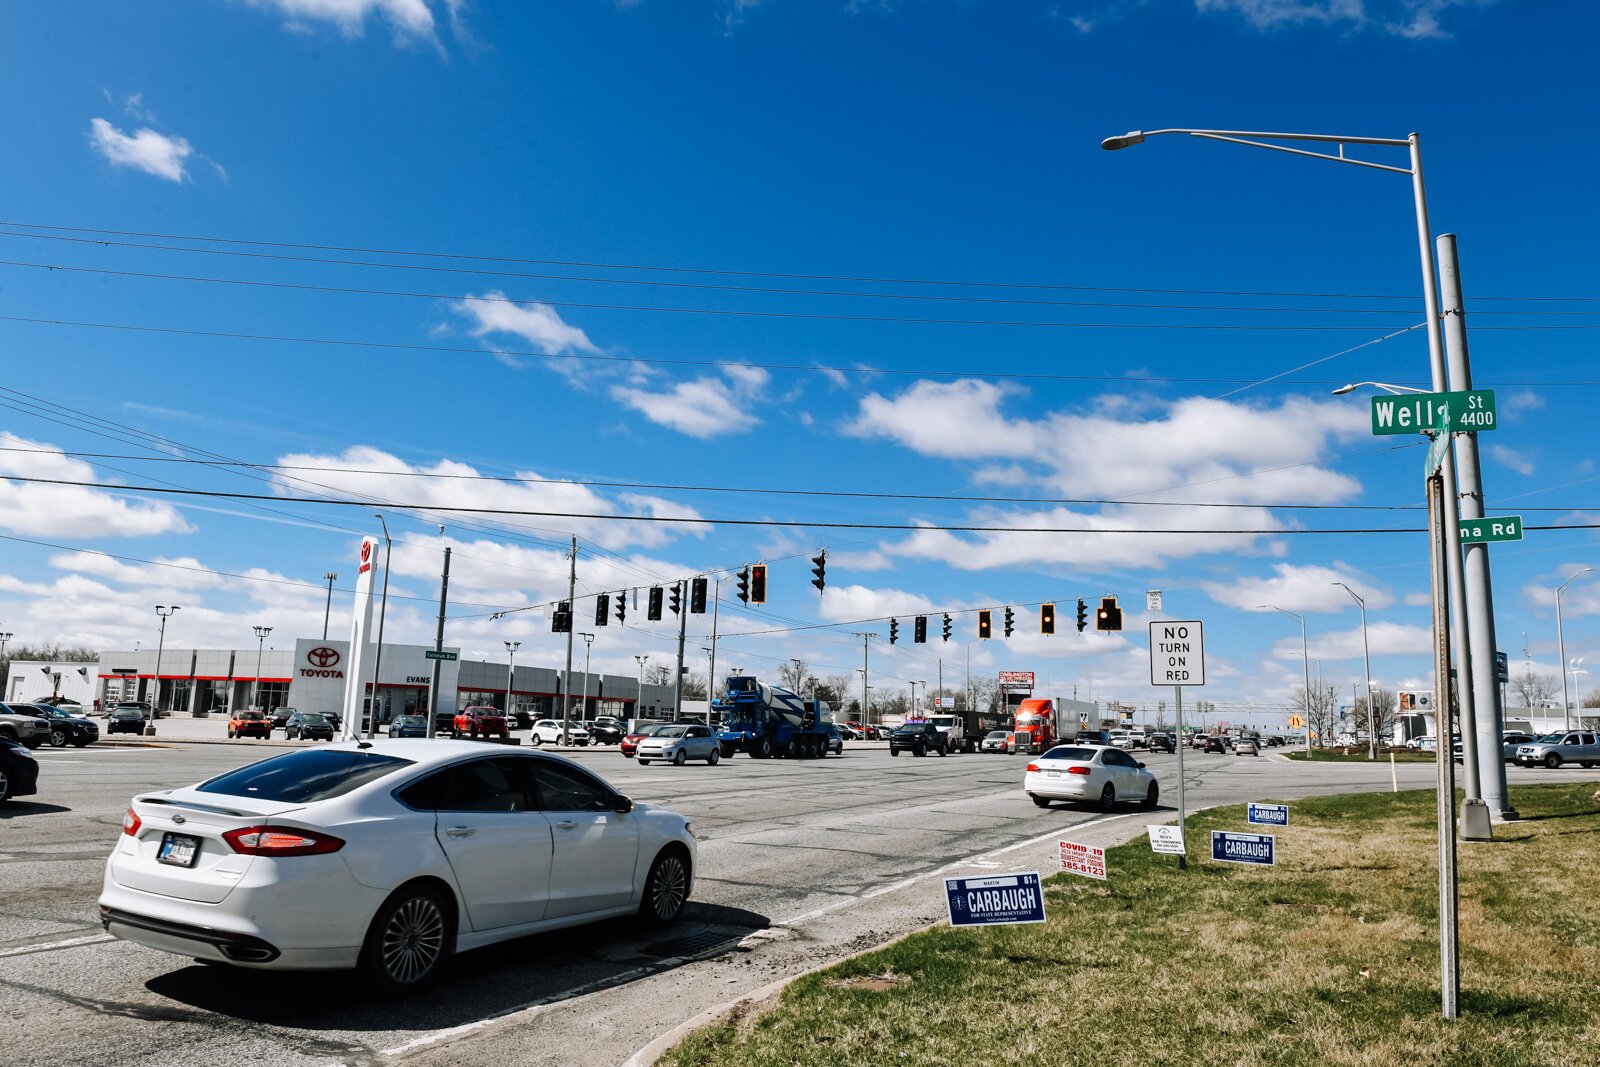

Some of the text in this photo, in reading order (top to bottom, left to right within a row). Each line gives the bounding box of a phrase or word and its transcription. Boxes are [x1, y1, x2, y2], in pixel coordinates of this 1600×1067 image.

[1468, 395, 1483, 410] St
[1460, 411, 1493, 426] 4400
[1492, 522, 1516, 536] Rd
[1165, 626, 1188, 640] NO
[1159, 643, 1190, 653] TURN
[1169, 656, 1186, 667] ON
[299, 669, 344, 679] TOYOTA
[407, 676, 431, 684] EVANS
[1166, 670, 1190, 681] RED
[1255, 809, 1285, 821] CARBAUGH
[1060, 841, 1087, 853] COVID
[1225, 841, 1269, 858] CARBAUGH
[1061, 860, 1105, 877] 385-8123
[967, 887, 1037, 914] CARBAUGH
[994, 910, 1032, 918] REPRESENTATIVE
